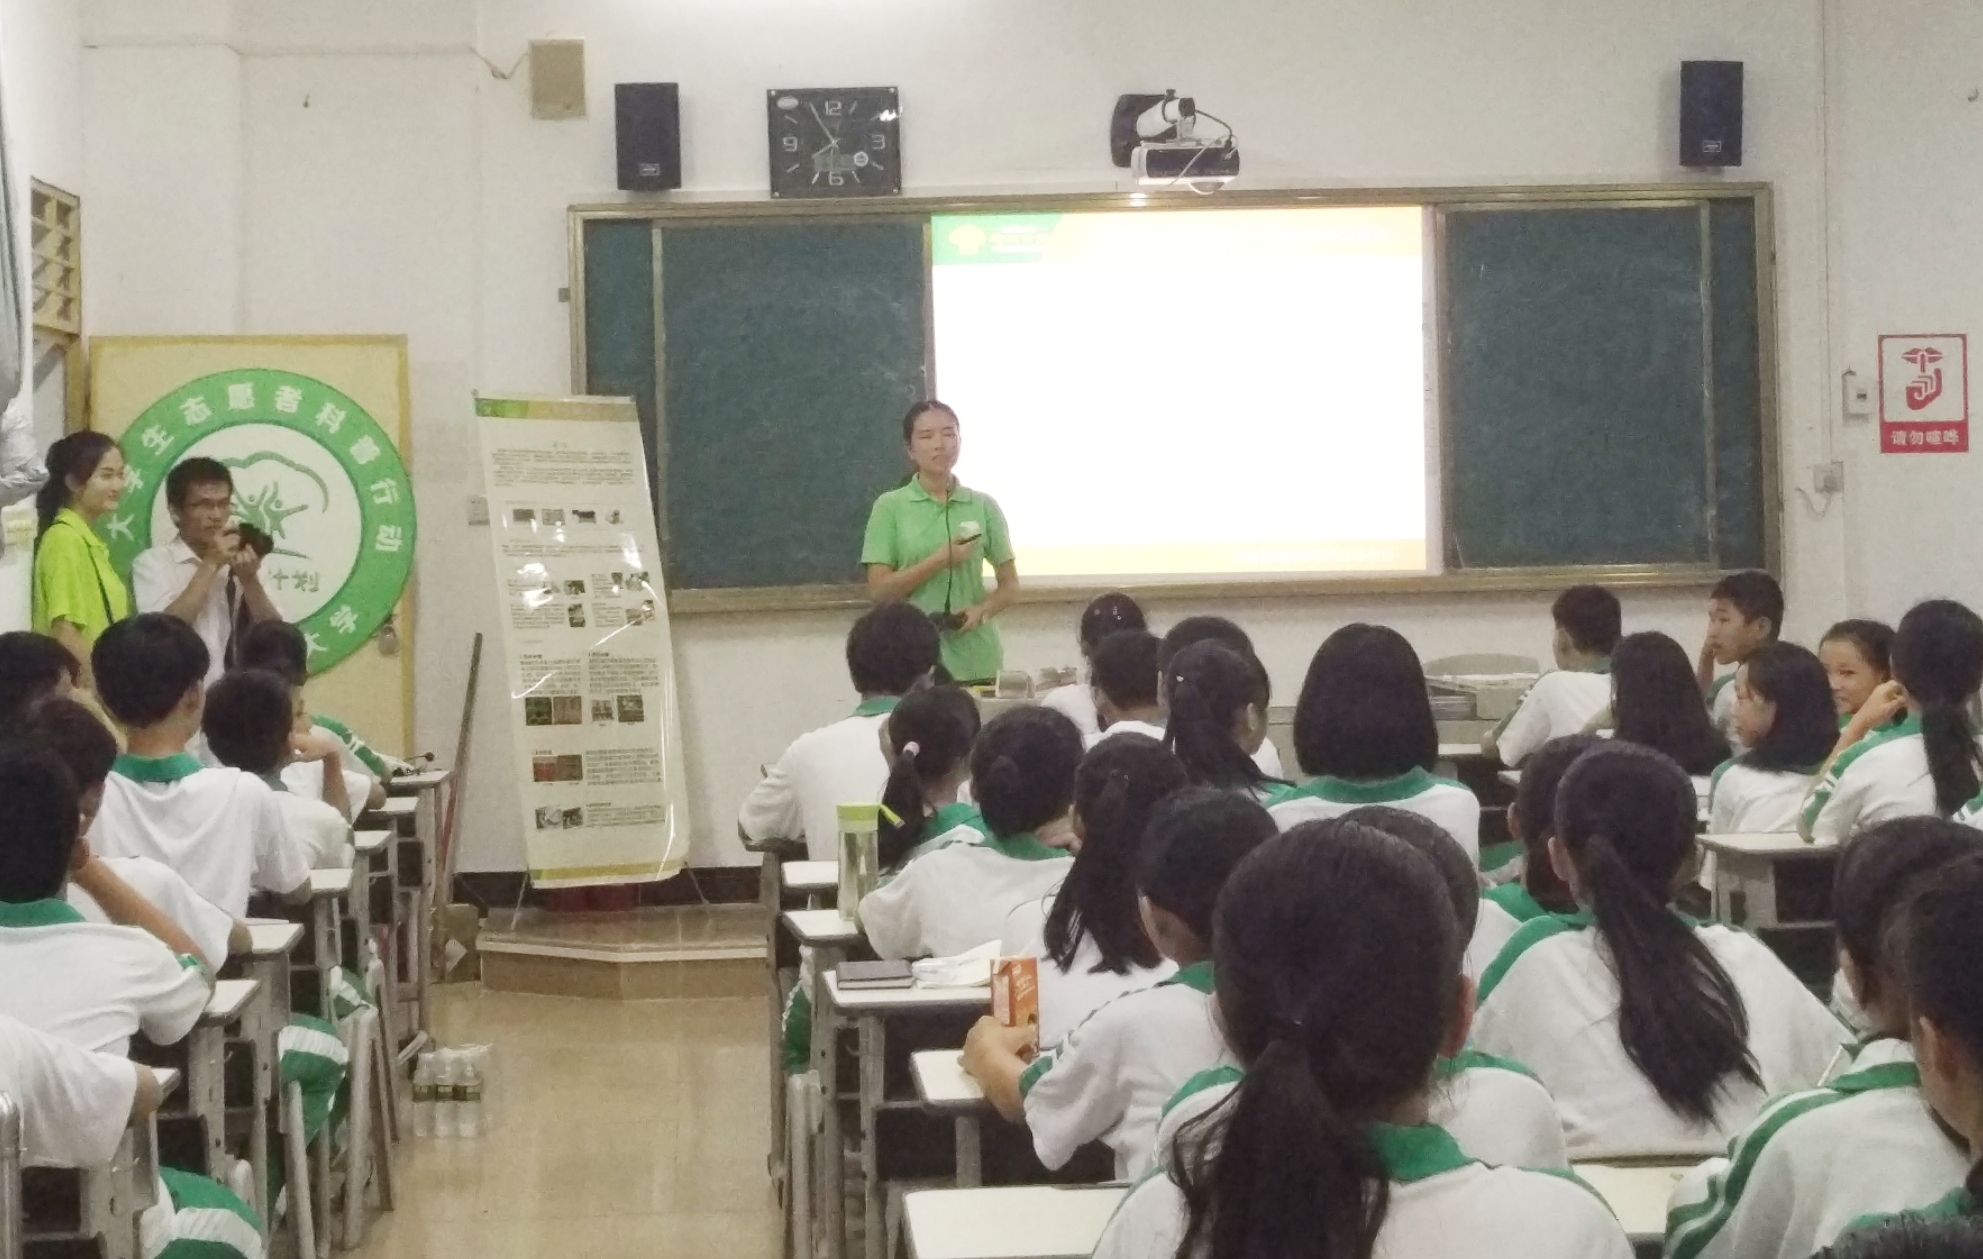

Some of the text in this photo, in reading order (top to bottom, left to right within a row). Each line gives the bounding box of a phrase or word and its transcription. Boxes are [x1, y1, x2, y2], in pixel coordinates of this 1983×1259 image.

[825, 101, 842, 116] 12
[781, 136, 798, 152] 9
[870, 134, 886, 150] 3
[827, 171, 845, 186] 6
[1891, 429, 1959, 445] 请勿喧哗
